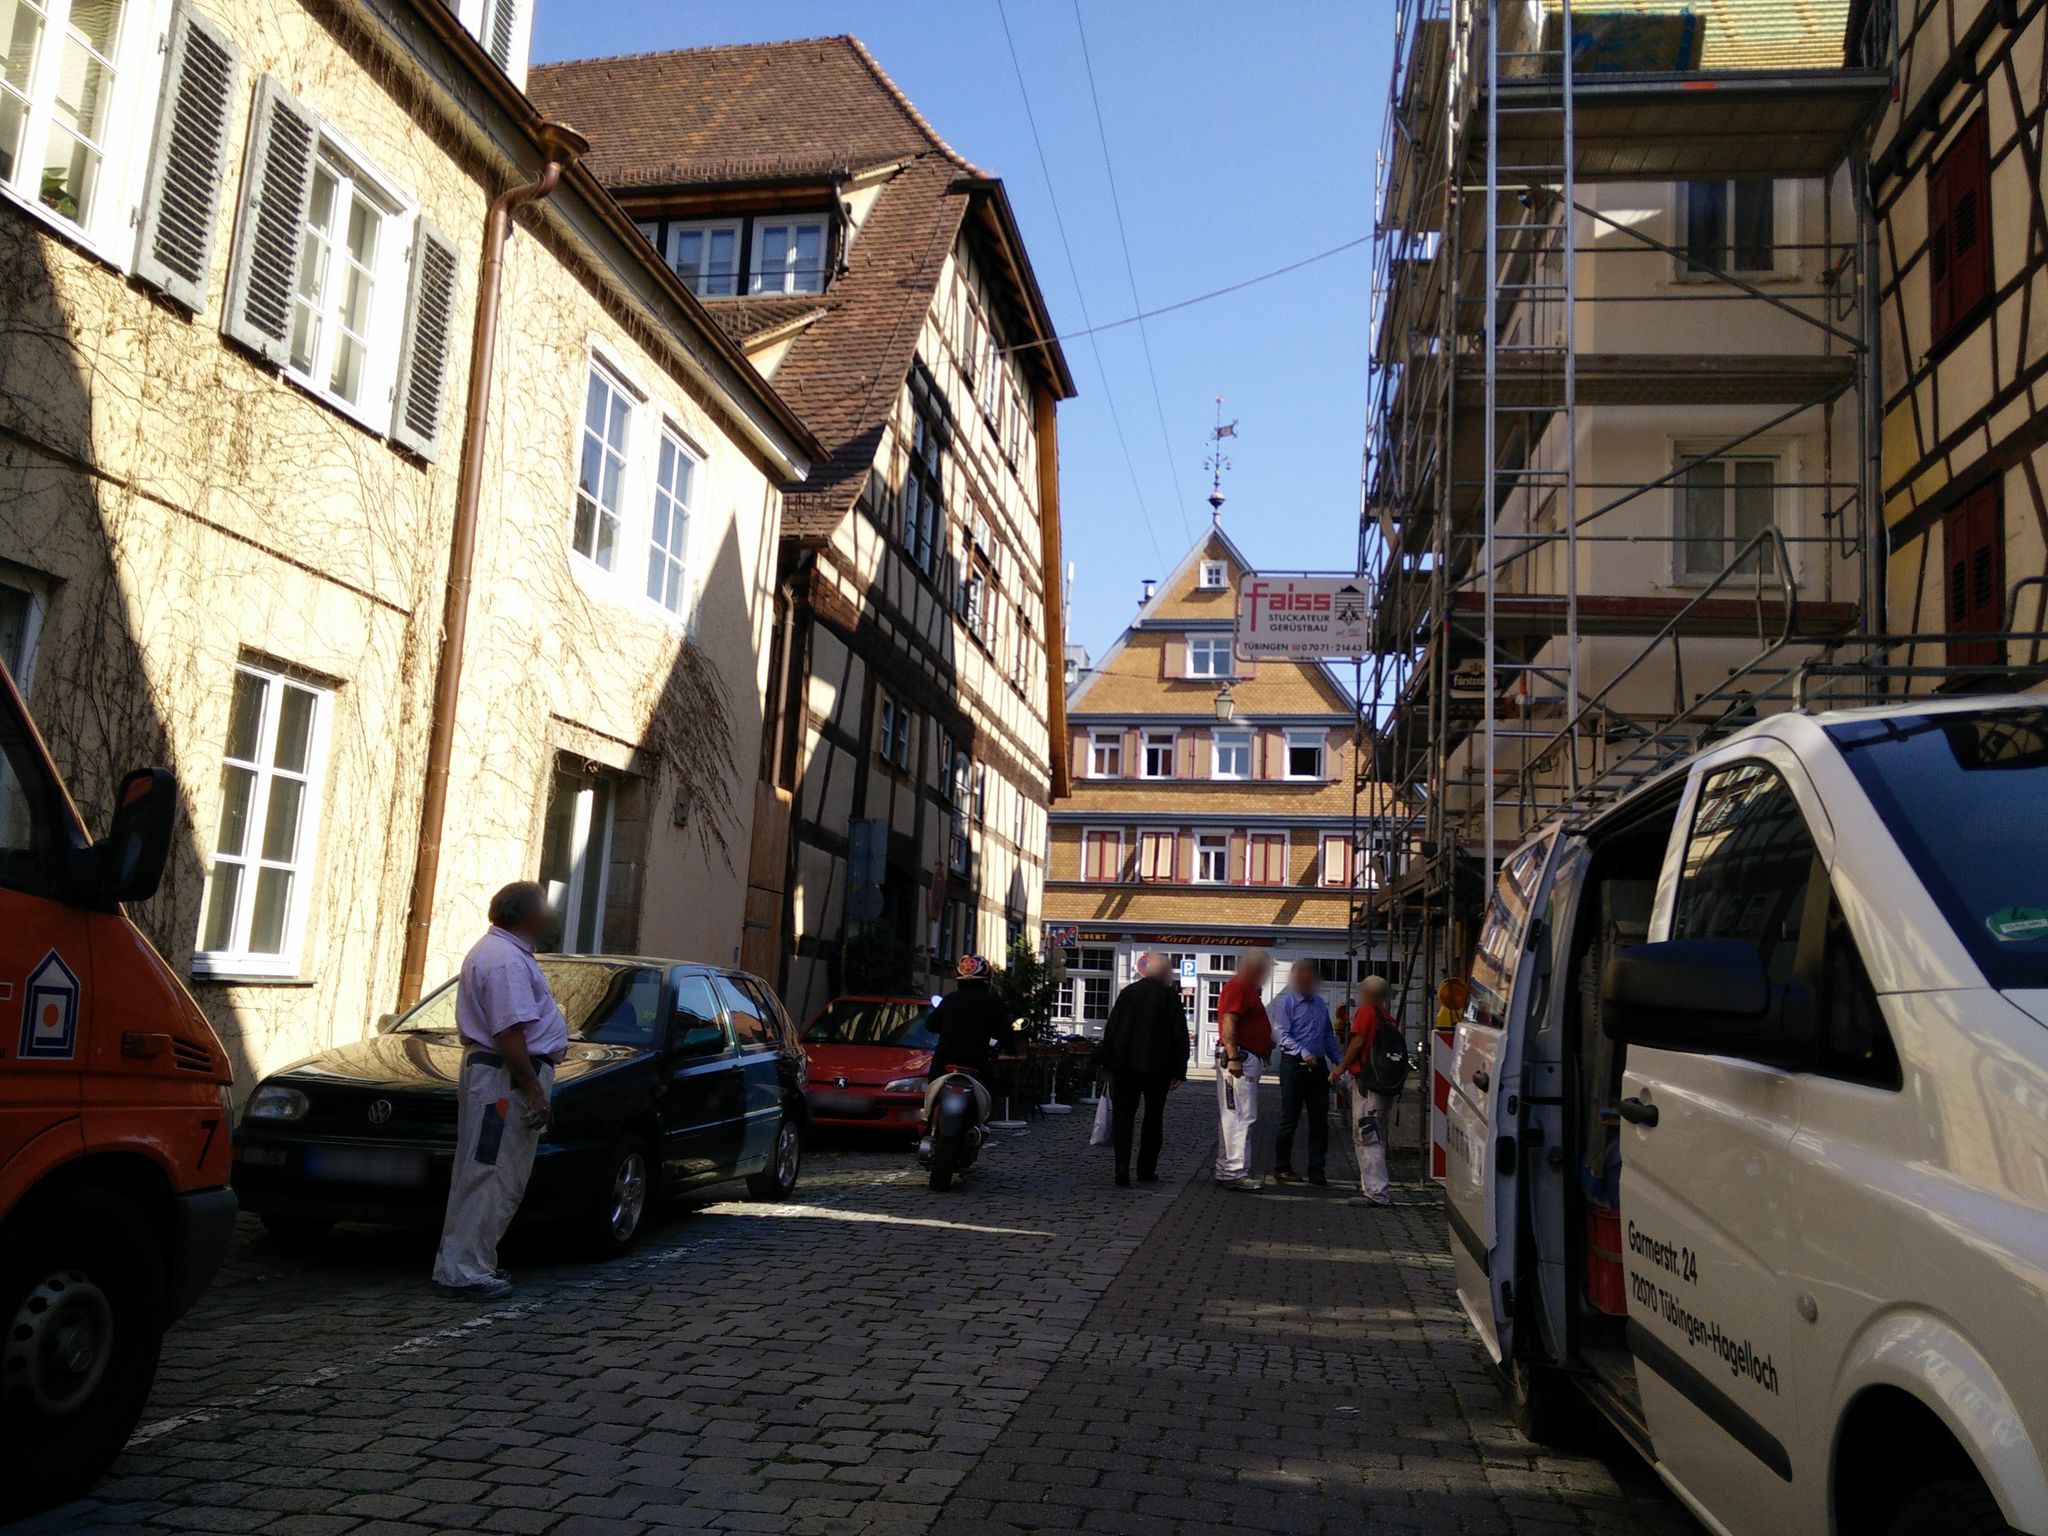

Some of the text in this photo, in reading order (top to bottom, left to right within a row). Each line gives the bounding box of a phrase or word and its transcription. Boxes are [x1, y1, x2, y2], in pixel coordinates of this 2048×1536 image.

[1244, 583, 1330, 632] faiss
[1268, 614, 1330, 622] STUCKATEUR
[1269, 623, 1328, 632] GERÜSTBAU
[1244, 642, 1289, 651] TÜBINGEN
[1454, 675, 1498, 688] Fürstenbg
[1160, 934, 1193, 944] Karl
[1183, 962, 1194, 976] P
[1628, 1220, 1698, 1286] Garmerstr. 24
[1631, 1271, 1779, 1395] 72070 Tübingen-Hagelloch
